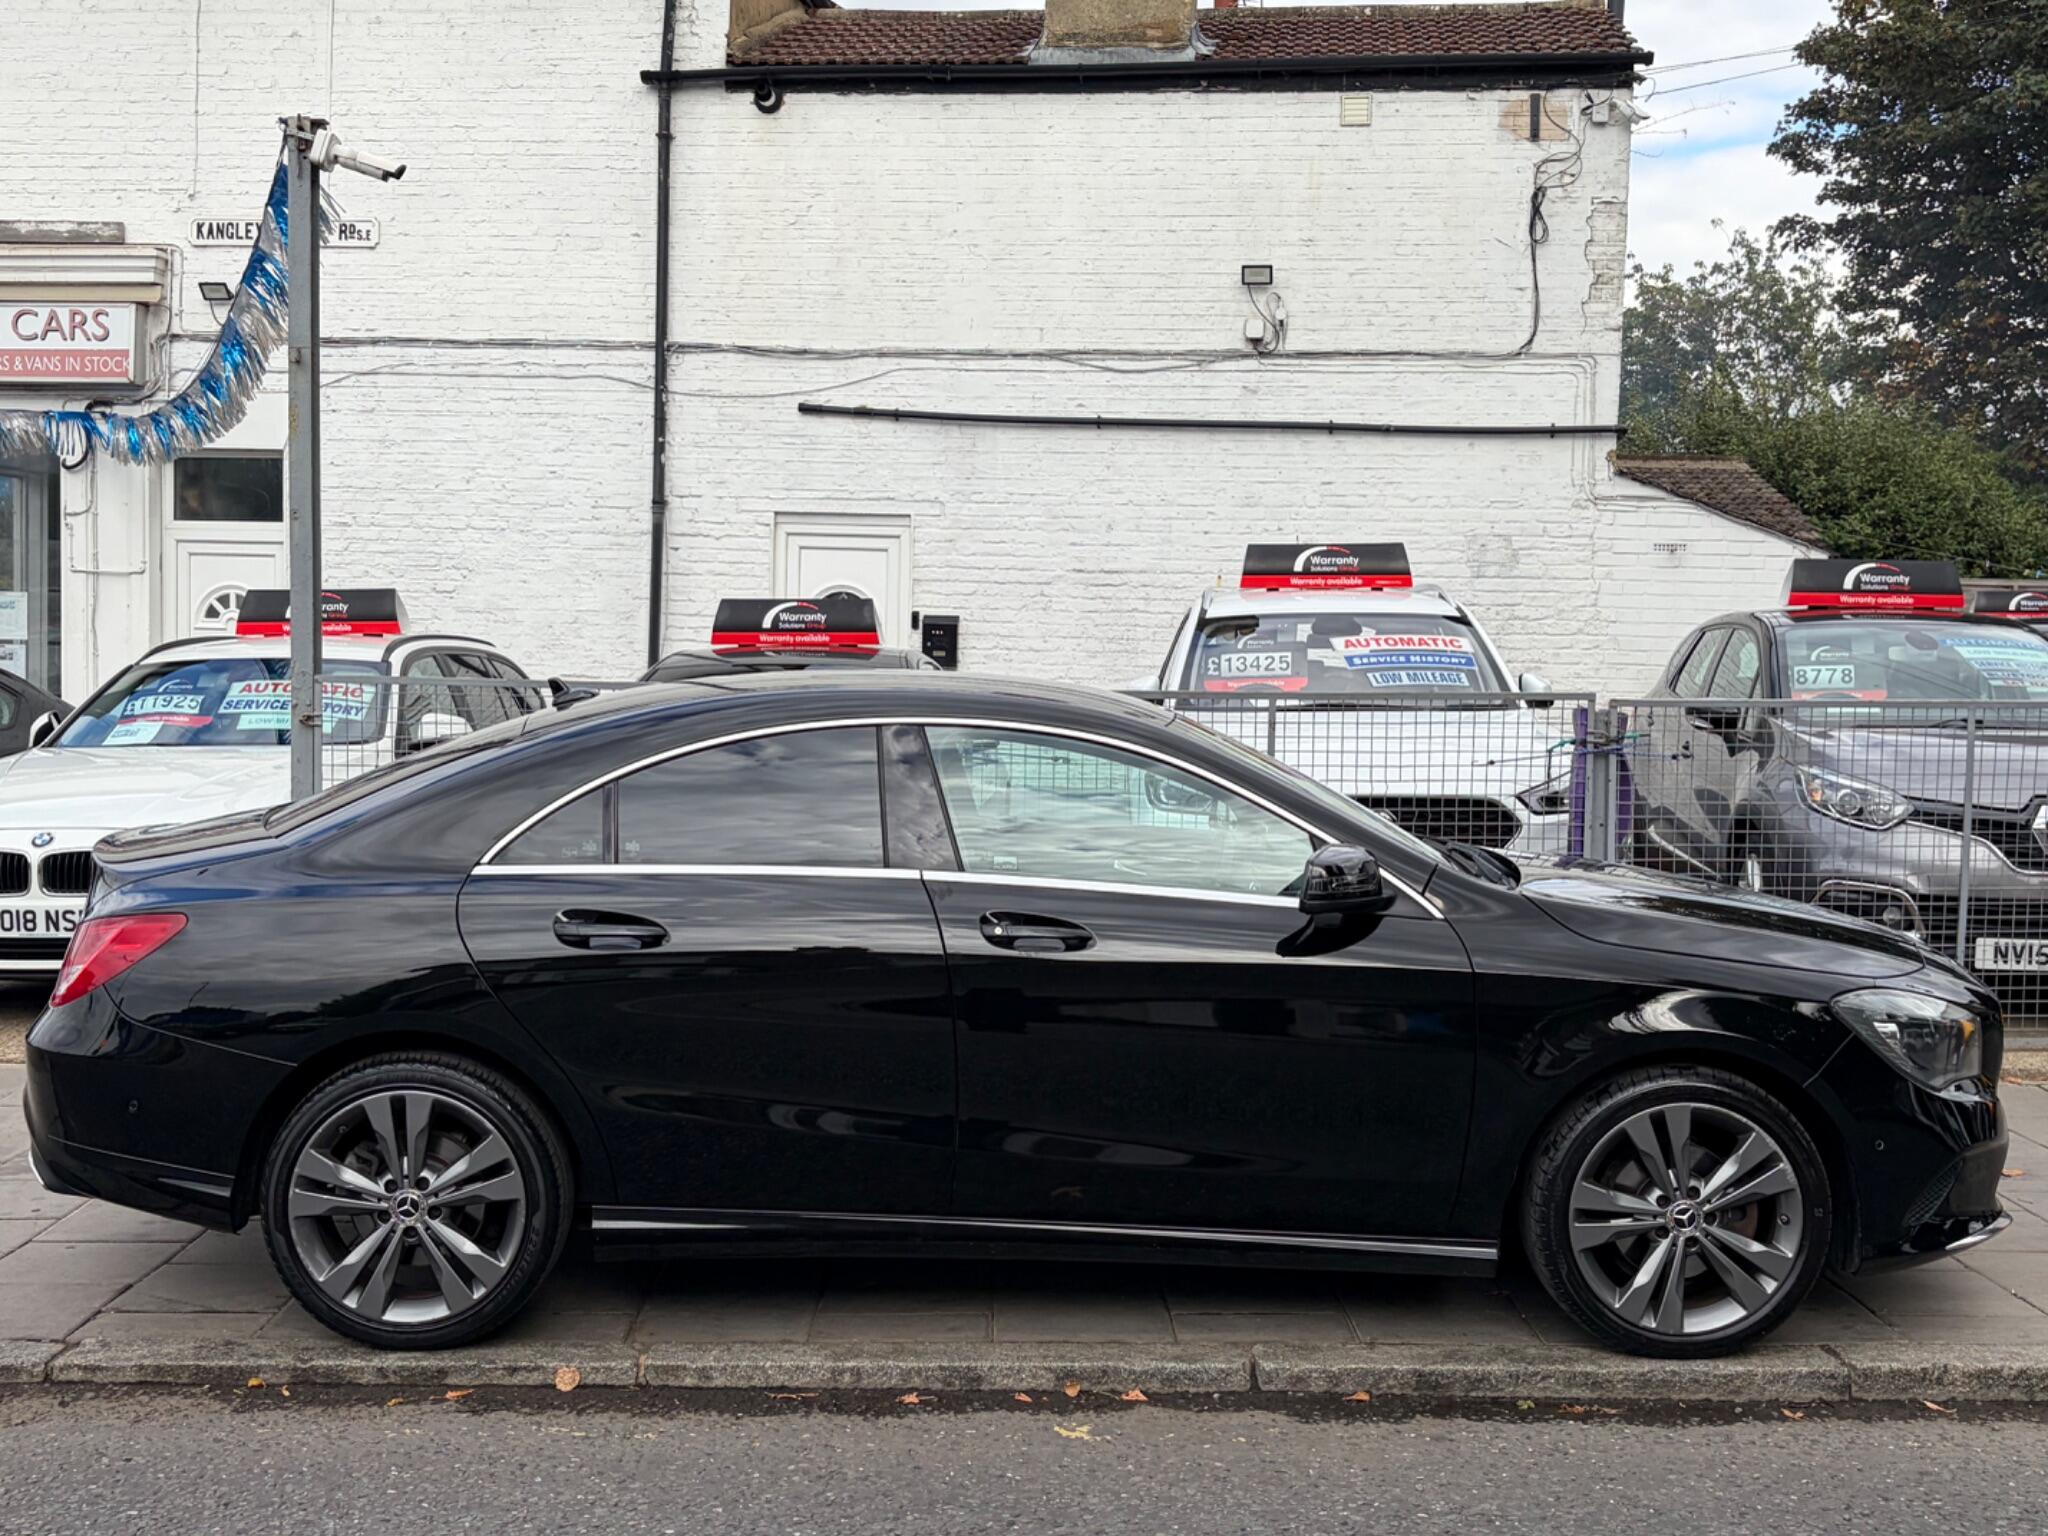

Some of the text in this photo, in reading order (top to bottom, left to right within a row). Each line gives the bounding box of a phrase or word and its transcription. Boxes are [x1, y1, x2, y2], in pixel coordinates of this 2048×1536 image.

[11, 308, 110, 341] CARS
[14, 356, 23, 371] &
[25, 356, 60, 371] VANS
[65, 357, 80, 371] IN
[84, 356, 129, 372] STOCK
[1311, 556, 1359, 567] Warranty
[1290, 576, 1363, 586] Warranty available
[1860, 573, 1910, 585] Warranty
[1840, 594, 1914, 604] Warranty available
[322, 603, 349, 613] ranty
[779, 612, 827, 623] Warranty
[760, 633, 830, 643] Warranty available
[1344, 637, 1463, 649] AUTOMATIC
[1207, 655, 1291, 676] £13425
[1352, 655, 1467, 665] SERVICE HISTORY
[1372, 672, 1465, 685] LOW MILEAGE
[1796, 668, 1853, 685] 8778
[223, 699, 290, 711] SERVICE
[45, 909, 83, 932] NS
